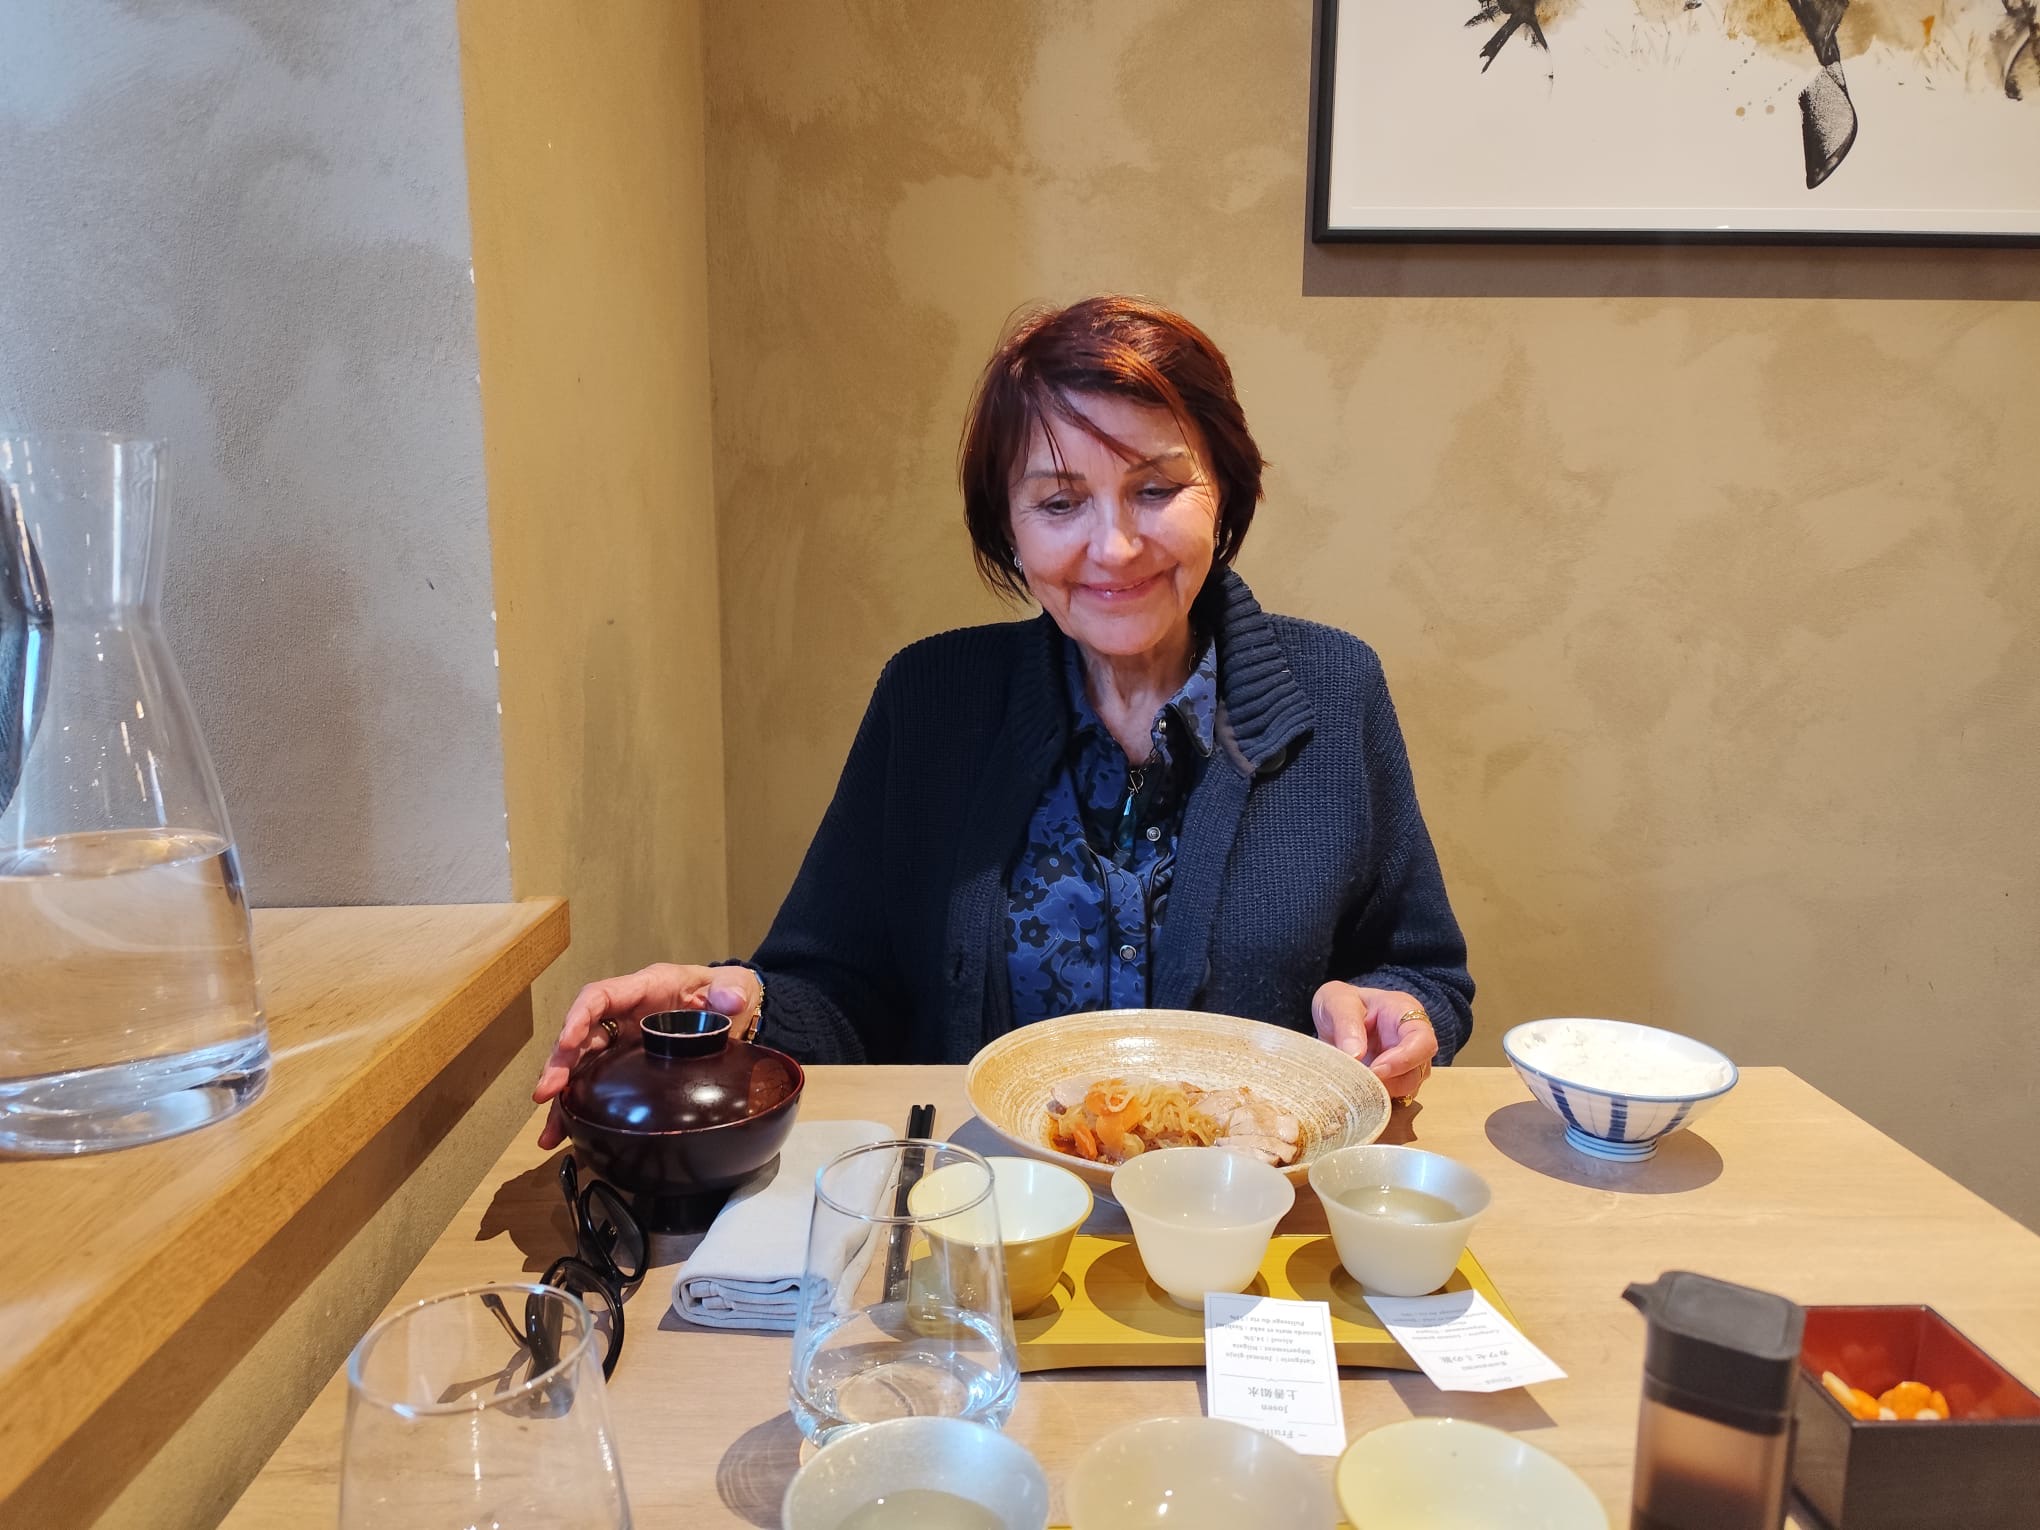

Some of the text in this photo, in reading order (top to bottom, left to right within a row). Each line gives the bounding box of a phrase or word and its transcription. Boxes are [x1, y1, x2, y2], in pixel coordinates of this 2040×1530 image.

[1247, 1387, 1297, 1400] 上善如水
[1260, 1404, 1288, 1413] Josen
